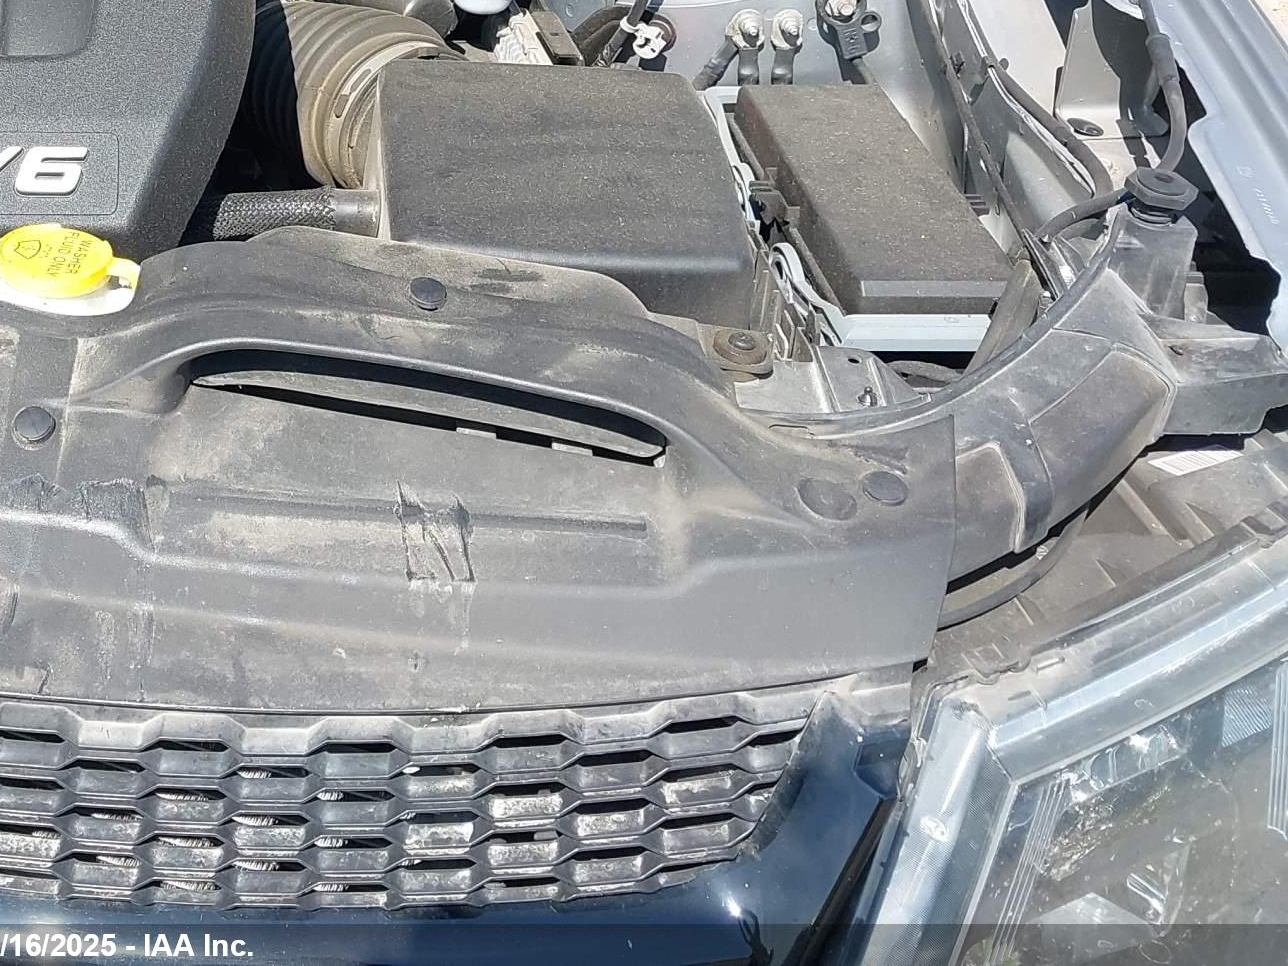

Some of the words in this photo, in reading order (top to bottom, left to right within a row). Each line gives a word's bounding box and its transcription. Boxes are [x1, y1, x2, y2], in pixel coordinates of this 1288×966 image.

[58, 231, 80, 256] FLUID
[47, 255, 66, 277] ONLY
[65, 240, 94, 275] WASHER
